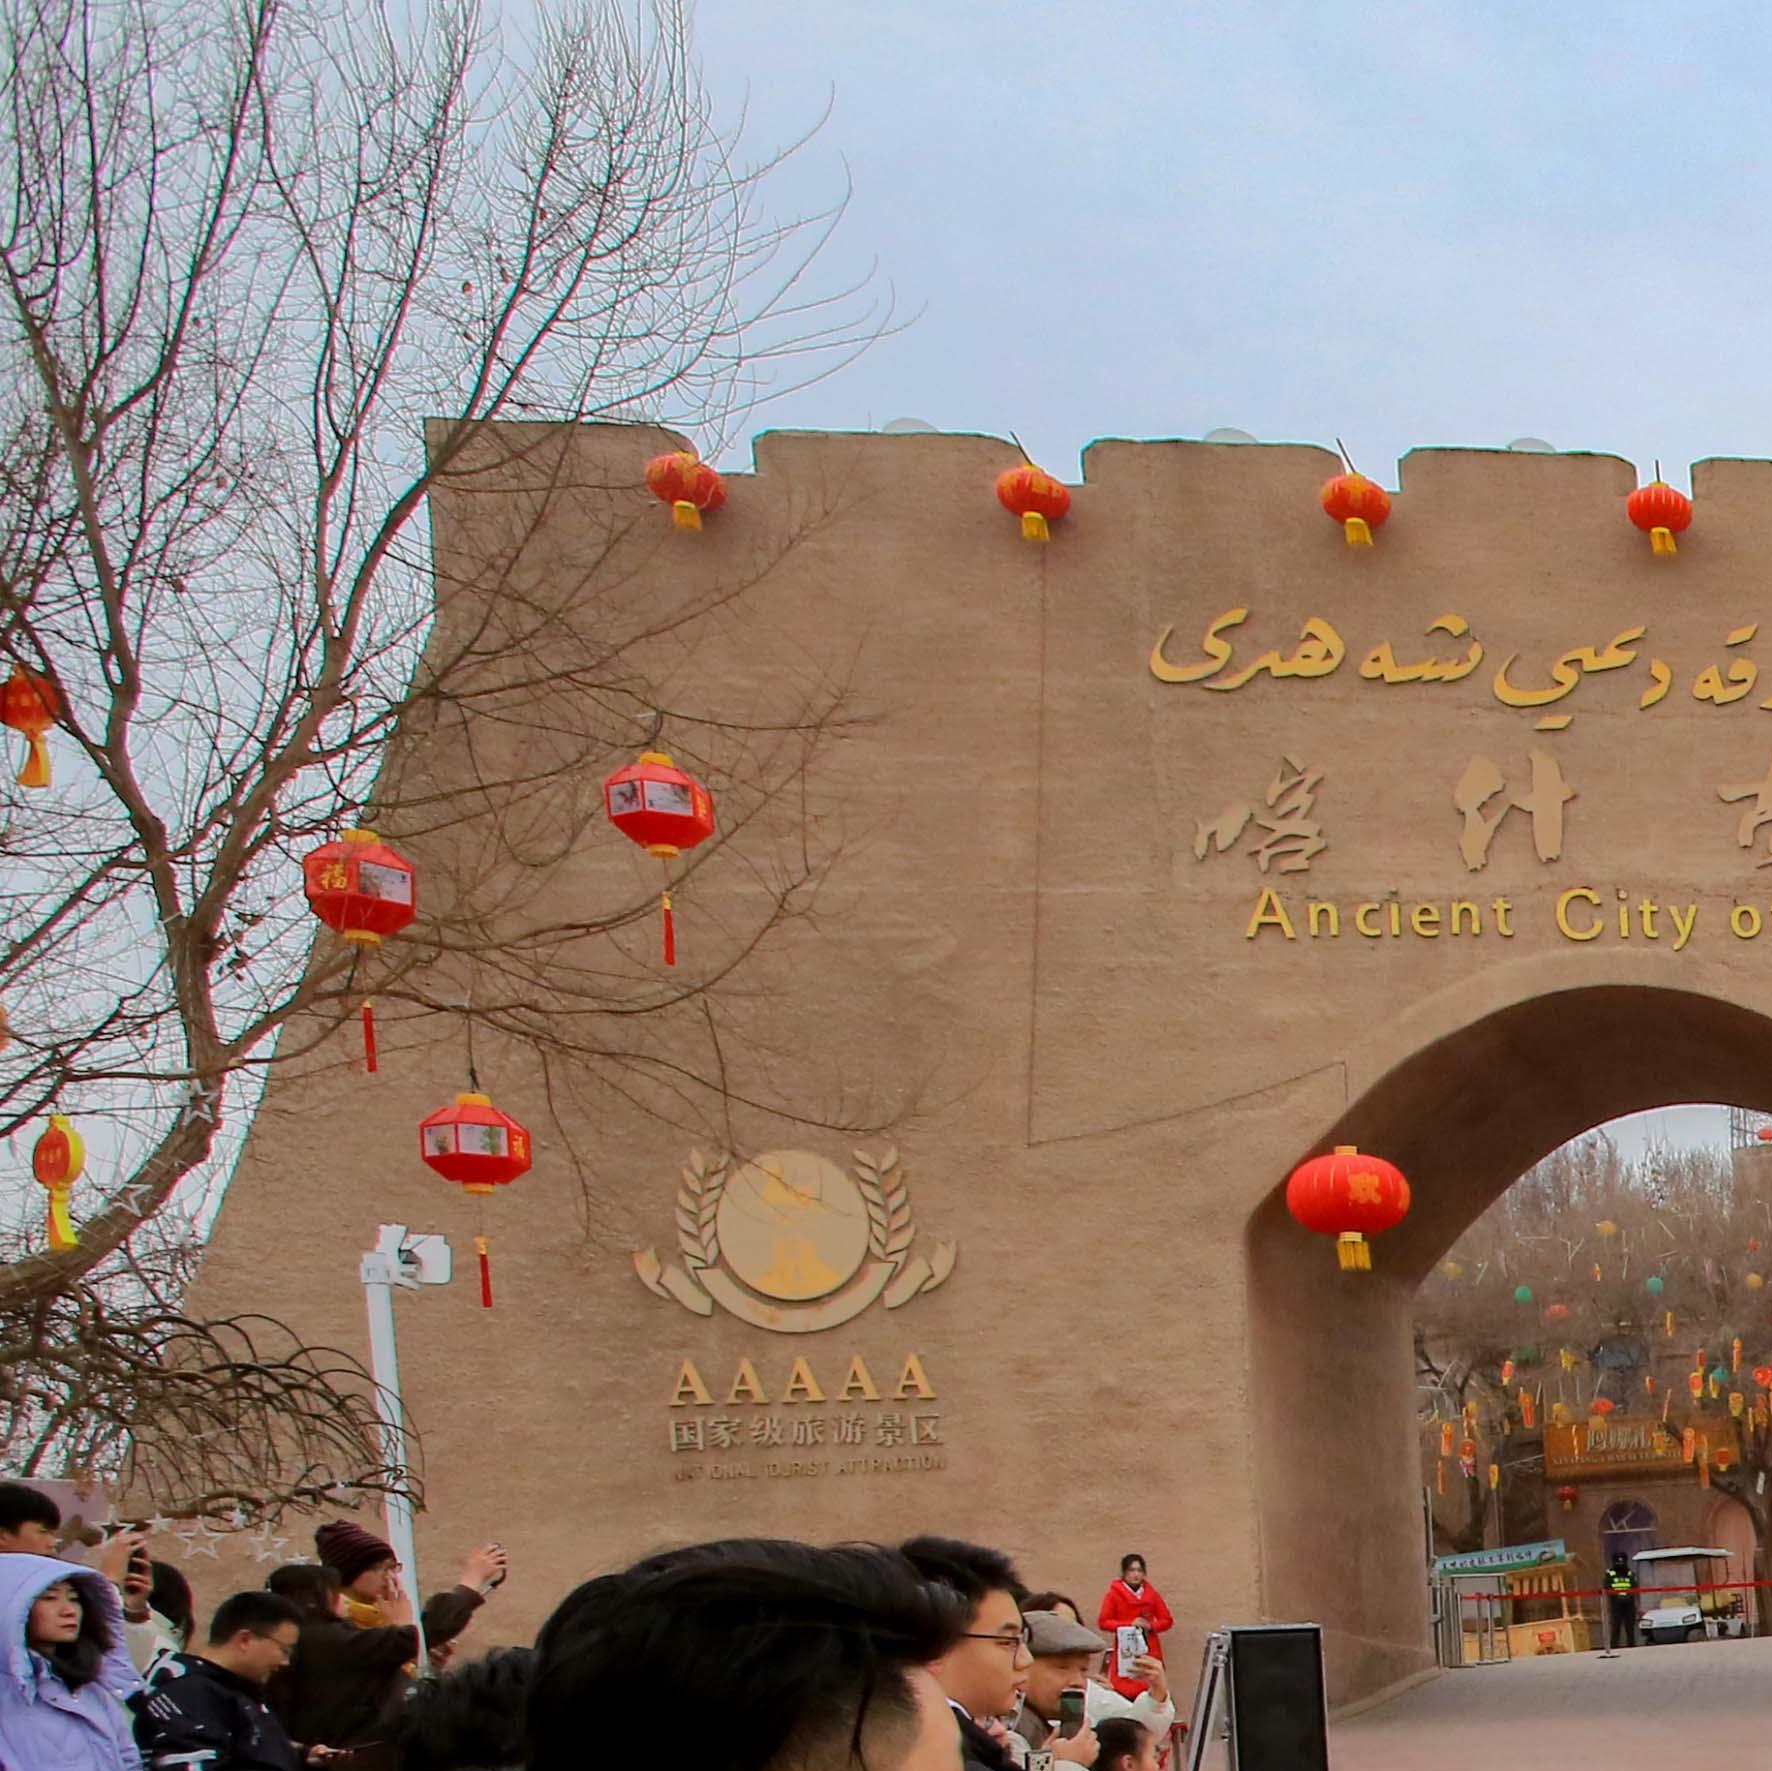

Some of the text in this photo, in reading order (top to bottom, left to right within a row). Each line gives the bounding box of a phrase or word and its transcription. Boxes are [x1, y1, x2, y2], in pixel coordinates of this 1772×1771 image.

[1245, 887, 1514, 940] Ancient
[1554, 887, 1700, 950] City
[669, 1412, 944, 1453] 国家级旅游景区
